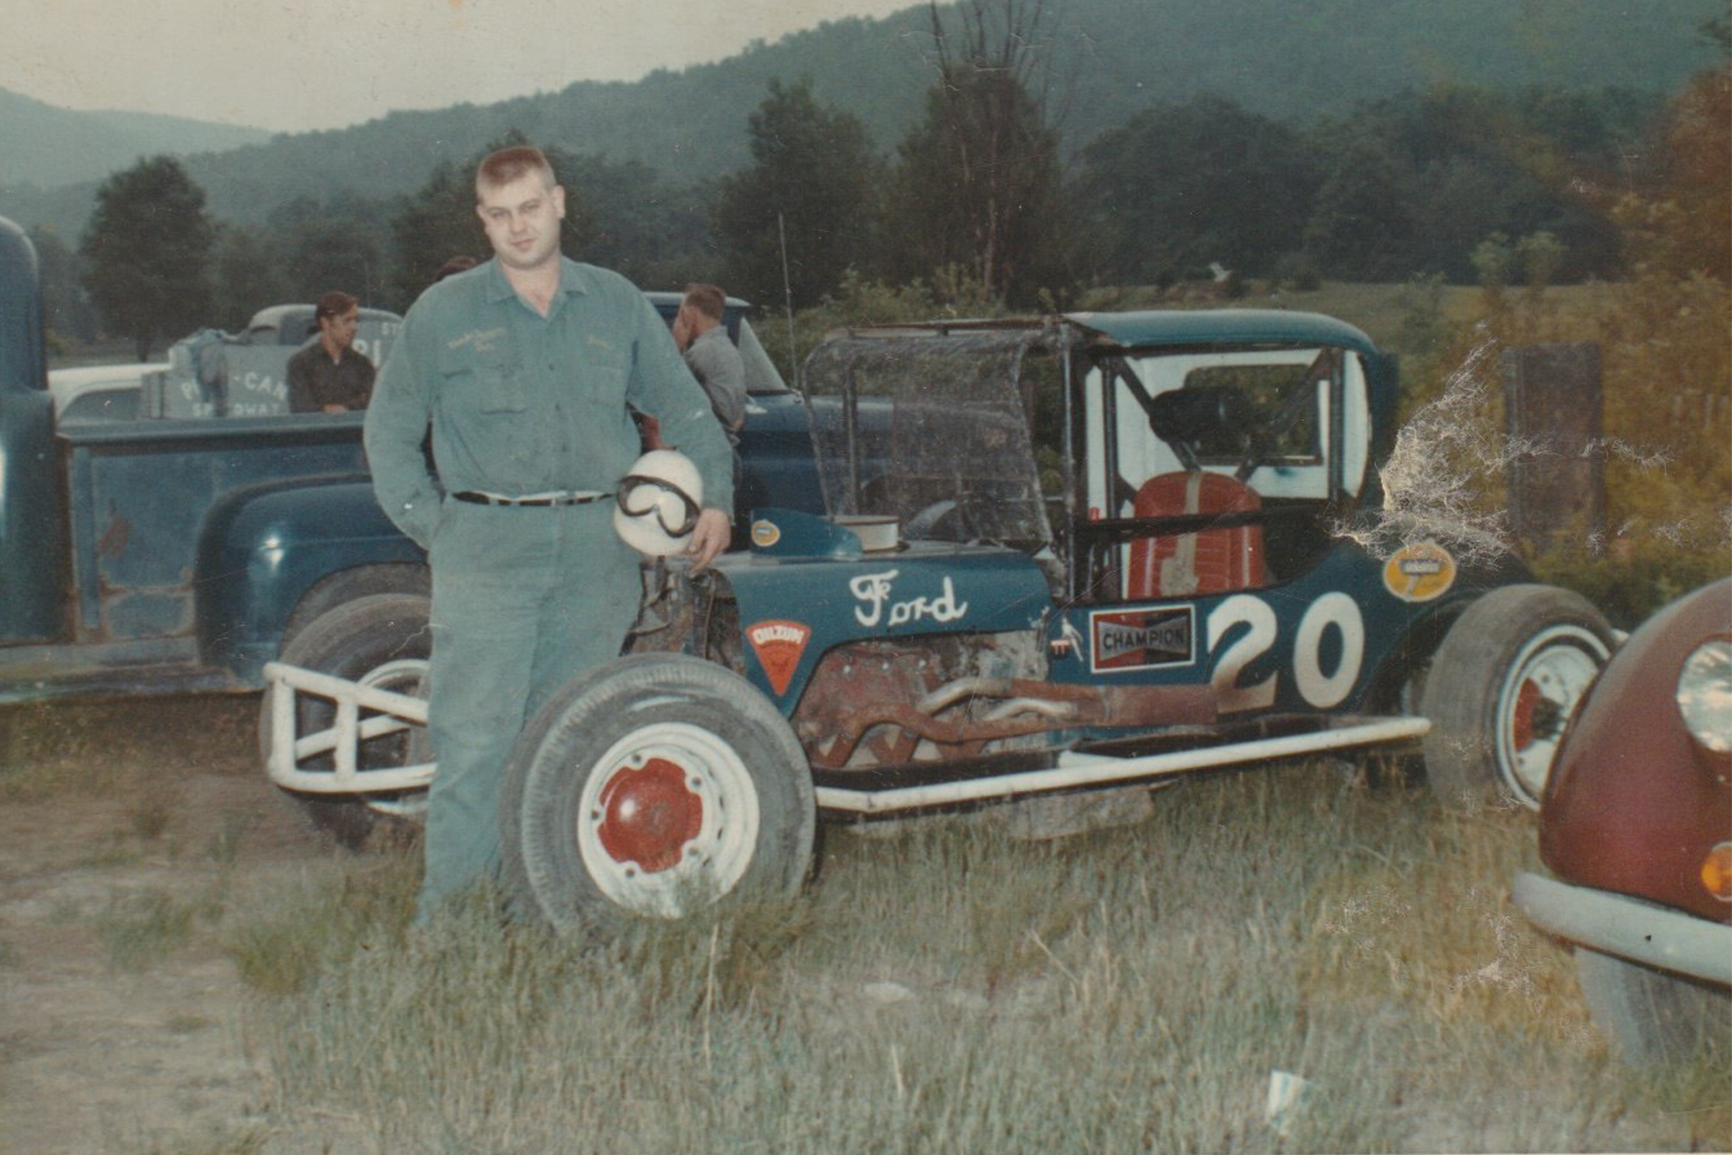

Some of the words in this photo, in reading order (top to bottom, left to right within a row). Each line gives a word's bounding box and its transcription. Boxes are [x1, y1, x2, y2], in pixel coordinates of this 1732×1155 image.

[191, 403, 281, 418] SPDWAY
[849, 569, 968, 627] Ford
[1102, 628, 1186, 652] CHAMPION
[1206, 591, 1365, 714] 20
